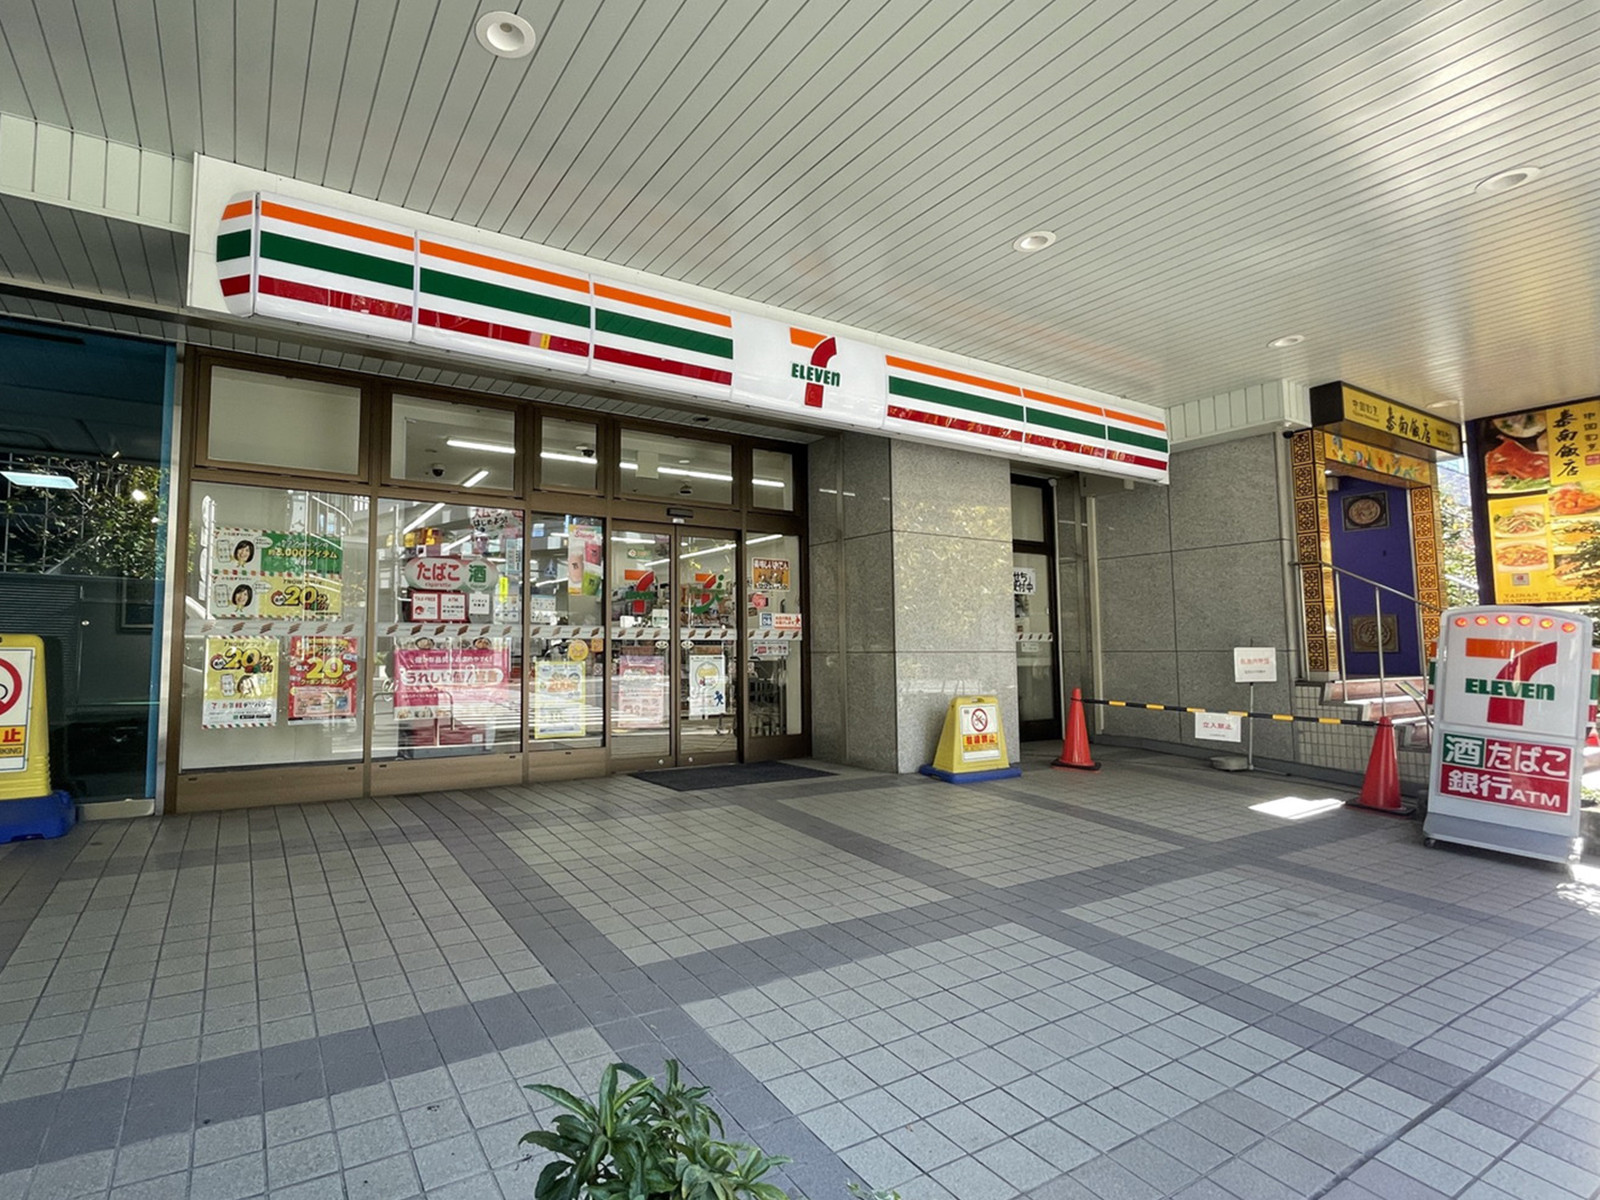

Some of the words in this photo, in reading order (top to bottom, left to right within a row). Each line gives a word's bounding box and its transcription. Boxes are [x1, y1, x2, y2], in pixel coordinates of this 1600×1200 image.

[789, 327, 837, 408] 7
[416, 561, 460, 581] たばこ
[468, 564, 487, 583] 酒
[1465, 637, 1558, 727] 7
[1444, 735, 1483, 766] 酒
[1486, 742, 1567, 777] たばこ
